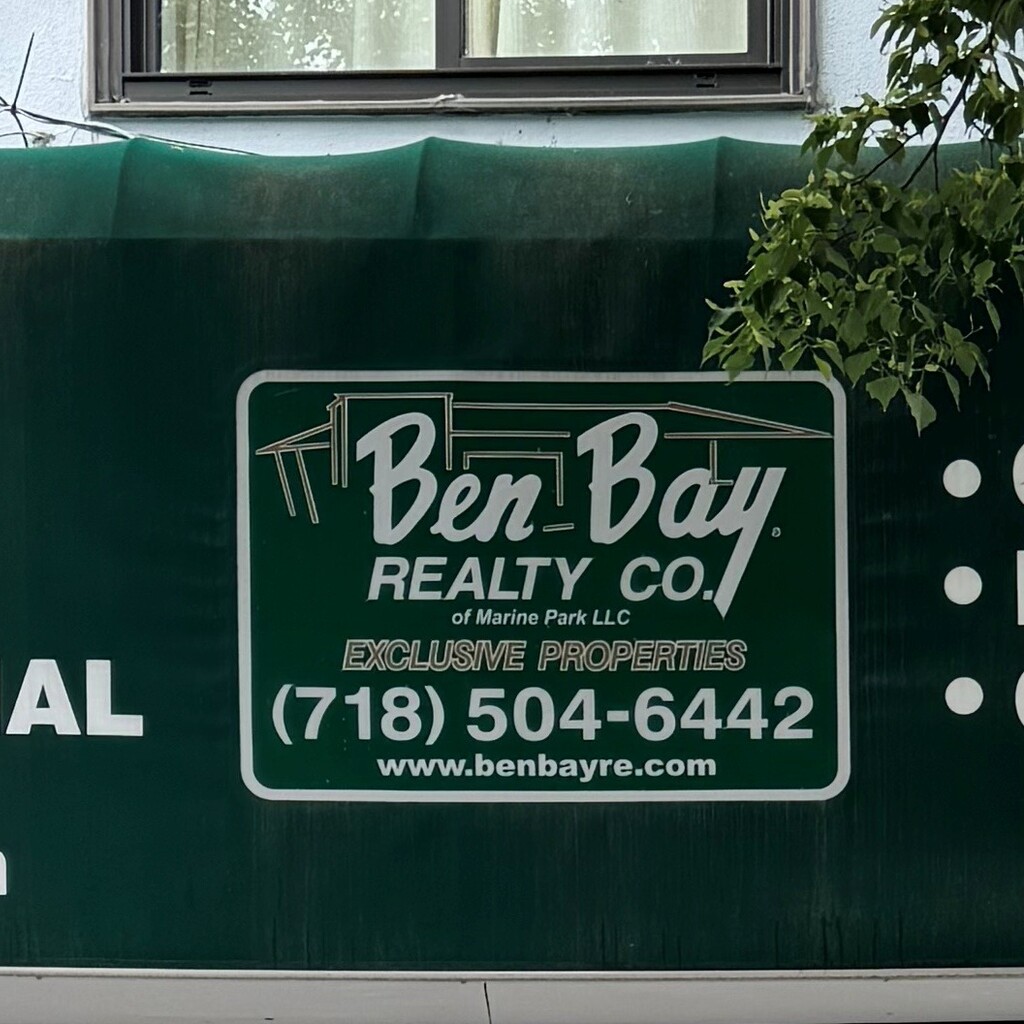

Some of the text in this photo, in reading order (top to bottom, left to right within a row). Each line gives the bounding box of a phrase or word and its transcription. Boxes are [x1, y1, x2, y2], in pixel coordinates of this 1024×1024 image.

[356, 411, 786, 619] Ben Bay
[367, 555, 714, 601] REALTY CO.
[451, 608, 632, 627] of Marine Park LLC
[342, 638, 748, 672] EXCLUSIVE PROPERTIES
[272, 683, 814, 746] (718) 504-6442
[376, 753, 717, 784] www.benbayre.com
